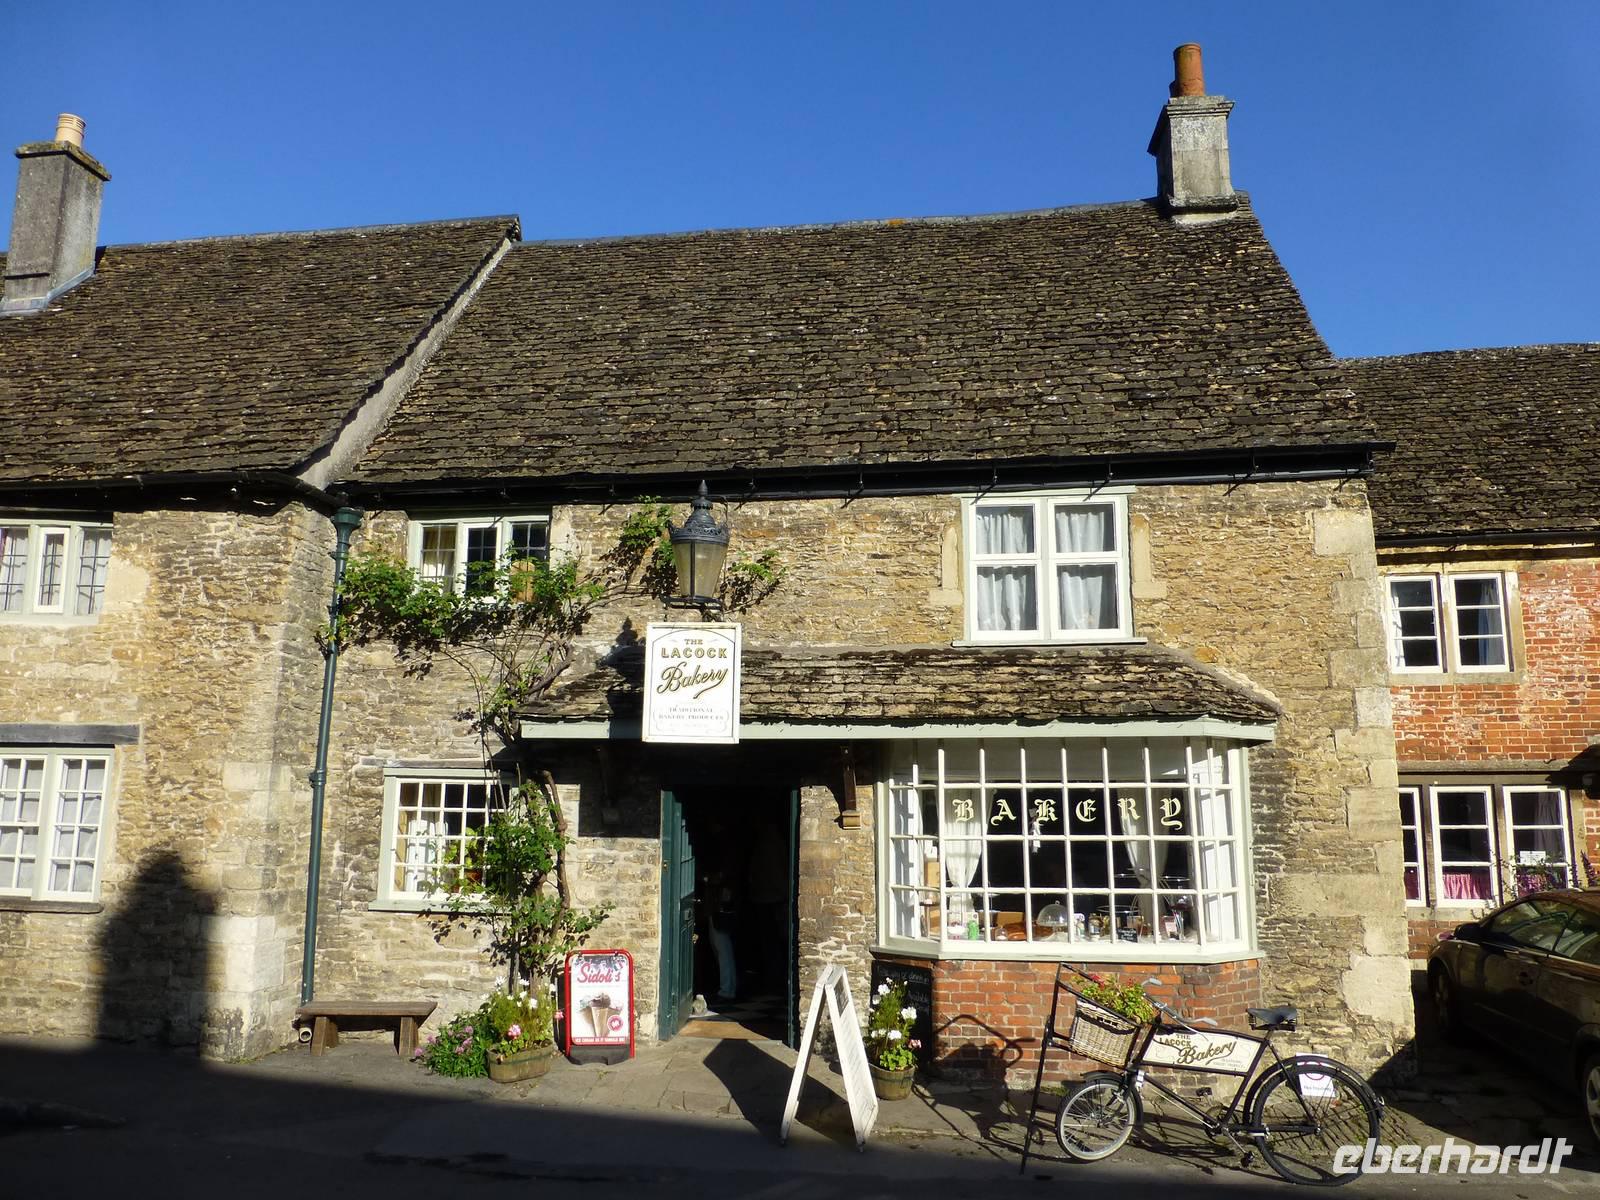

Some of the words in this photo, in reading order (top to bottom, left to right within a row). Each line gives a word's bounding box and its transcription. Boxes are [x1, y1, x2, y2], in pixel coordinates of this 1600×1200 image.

[661, 647, 727, 659] LACOCK
[656, 661, 728, 700] Bakery
[952, 797, 1183, 831] BAKERY
[577, 962, 621, 983] Sidoli's
[1159, 1037, 1192, 1047] LACOCK
[1177, 1041, 1237, 1066] Bakery
